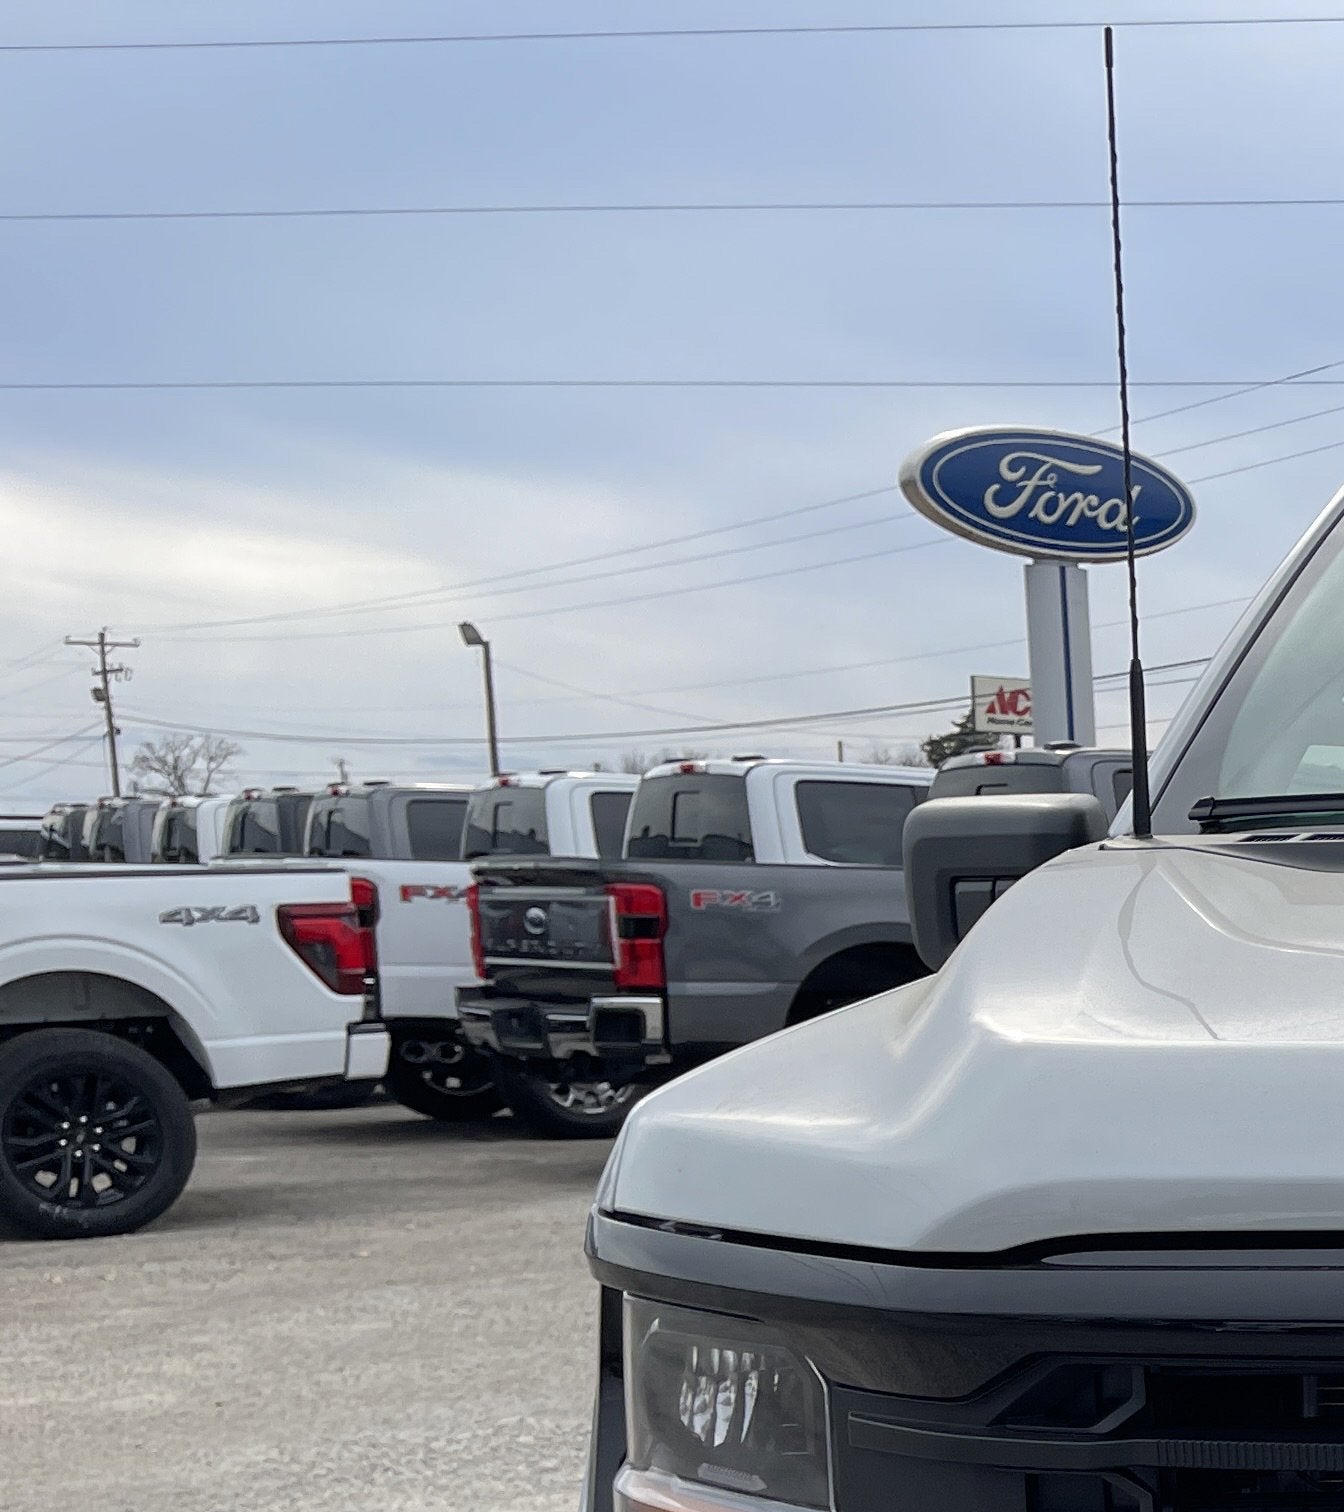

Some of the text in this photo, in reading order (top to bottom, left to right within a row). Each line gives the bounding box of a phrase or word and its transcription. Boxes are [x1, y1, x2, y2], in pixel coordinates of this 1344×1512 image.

[984, 451, 1142, 532] Ford
[985, 686, 1031, 717] AC
[690, 888, 780, 912] FX4
